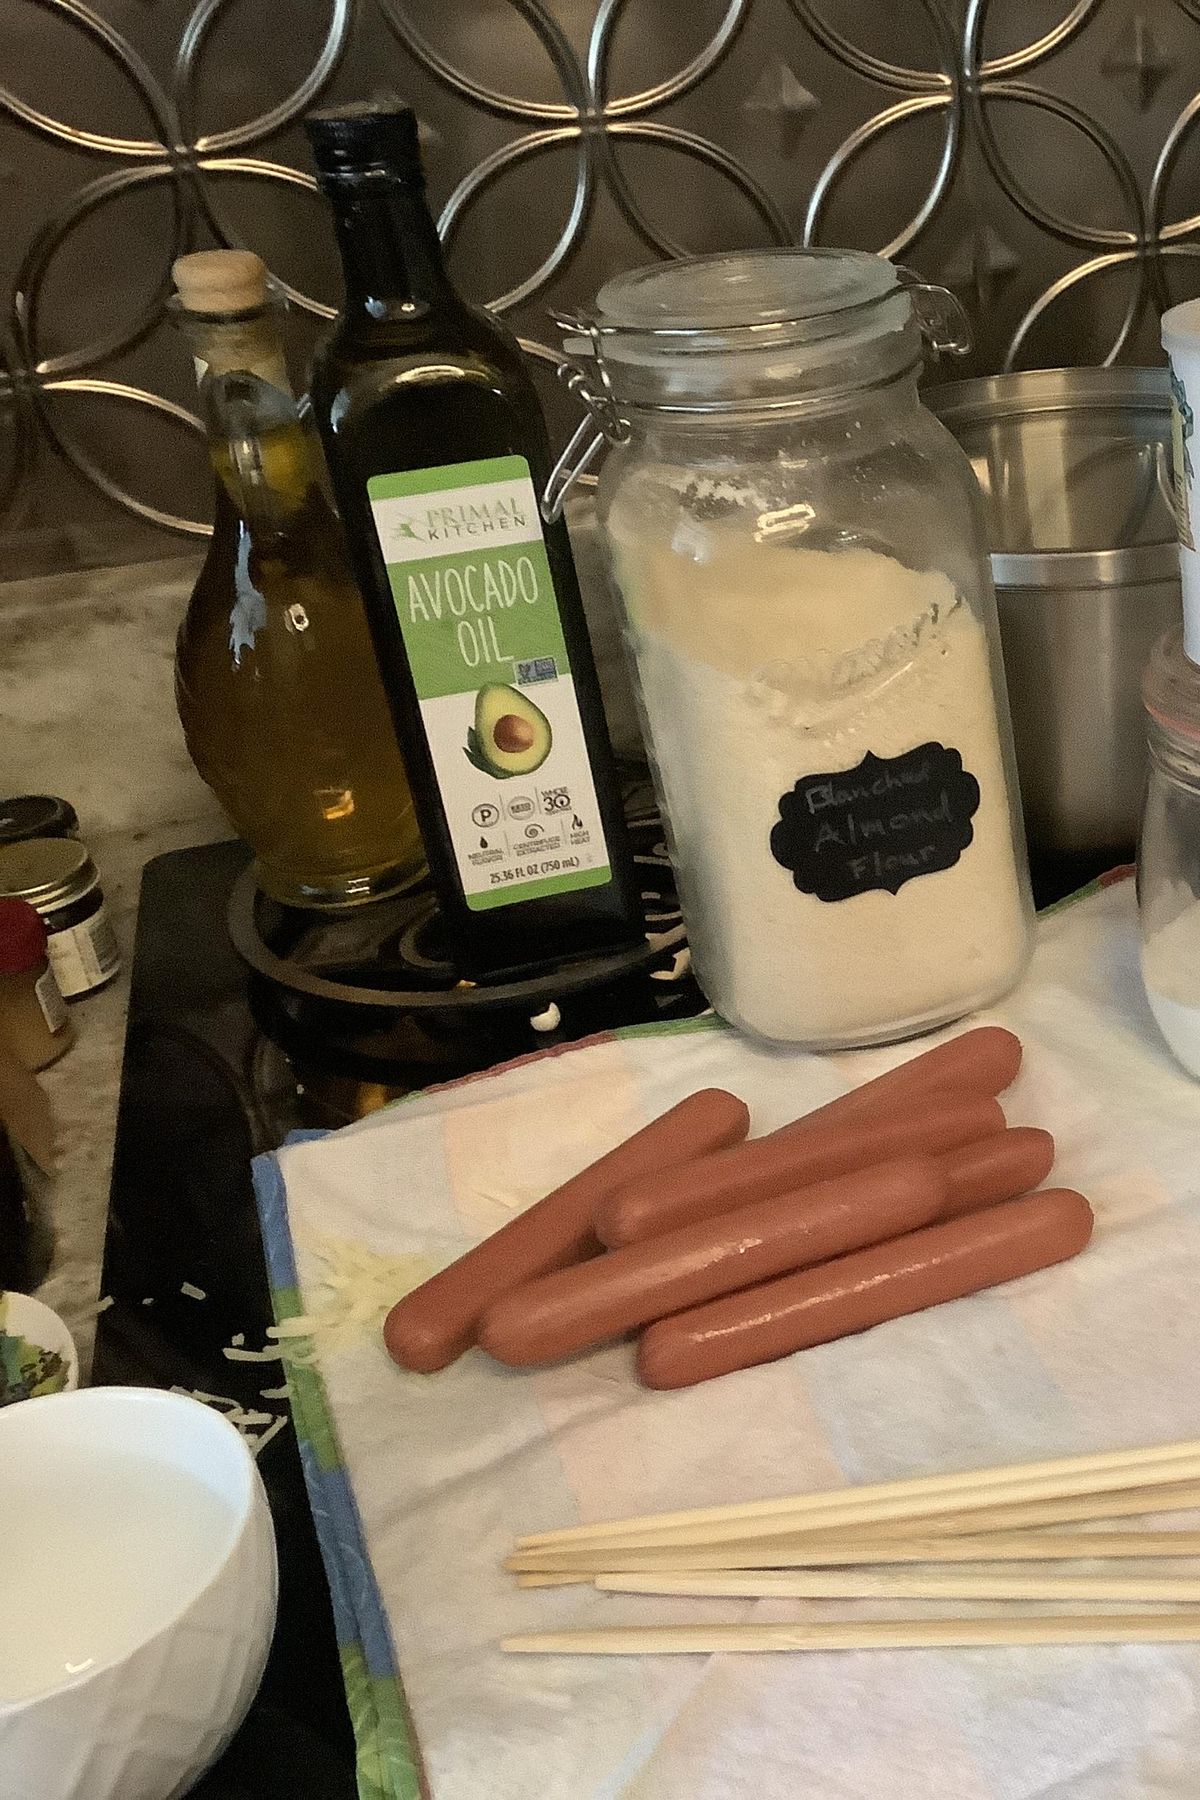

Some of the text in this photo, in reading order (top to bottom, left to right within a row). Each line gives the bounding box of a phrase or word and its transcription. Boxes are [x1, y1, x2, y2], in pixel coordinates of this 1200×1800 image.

[425, 497, 525, 528] PRIMAL
[428, 515, 526, 540] KITCHEN
[407, 556, 539, 623] AVOCADO
[457, 615, 514, 667] OIL
[480, 809, 492, 822] P
[814, 788, 953, 853] Almond
[490, 856, 580, 884] 25.36 FL OZ (750 mL)
